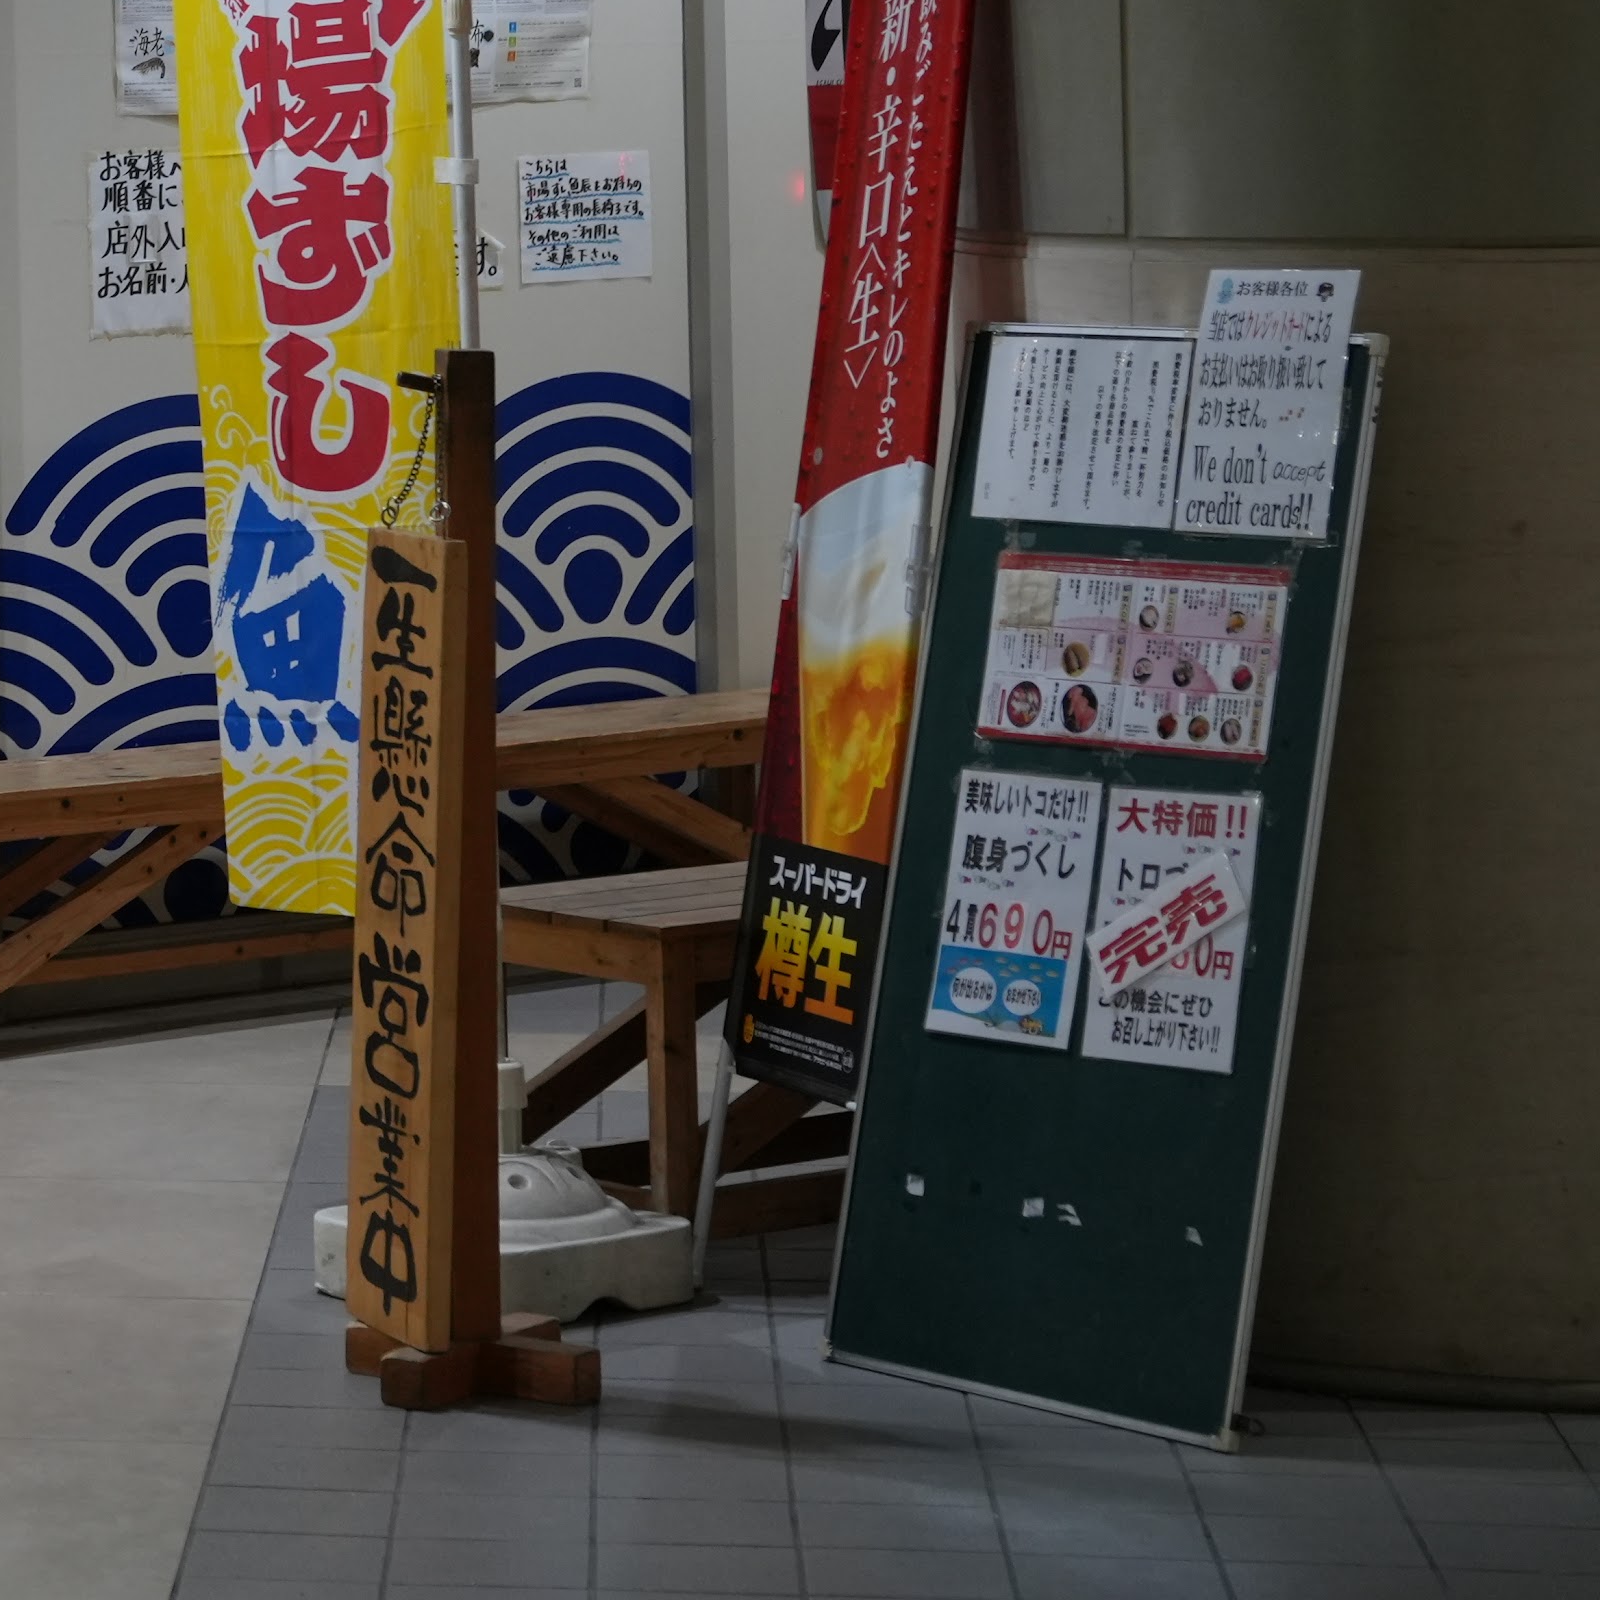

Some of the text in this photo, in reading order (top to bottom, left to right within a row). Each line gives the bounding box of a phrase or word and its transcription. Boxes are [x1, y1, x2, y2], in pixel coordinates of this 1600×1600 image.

[523, 159, 567, 180] こちらは
[101, 180, 183, 213] 順番に
[525, 199, 644, 221] お客様専用の長椅子です。
[101, 221, 186, 259] 店外入
[528, 224, 619, 245] その他のご利用は
[535, 245, 618, 268] ご遠慮下さい。
[1237, 281, 1308, 298] お客様各位
[1207, 310, 1333, 343] 当店ではクレジットカードによる
[1200, 352, 1327, 390] お支払いはお取り扱い致して
[1198, 398, 1267, 429] おりません。
[1193, 443, 1326, 485] We don't accept
[1186, 493, 1313, 529] credit cards!!
[964, 780, 1089, 823] 美味しいトコだけ!!
[1117, 797, 1248, 839] 大特価!!
[962, 834, 1075, 879] 腹身づくし
[769, 855, 868, 909] スーパードライ
[1099, 873, 1228, 984] 完売
[755, 896, 857, 1026] 樽生
[1111, 1017, 1220, 1053] お召し上がり下さい!!
